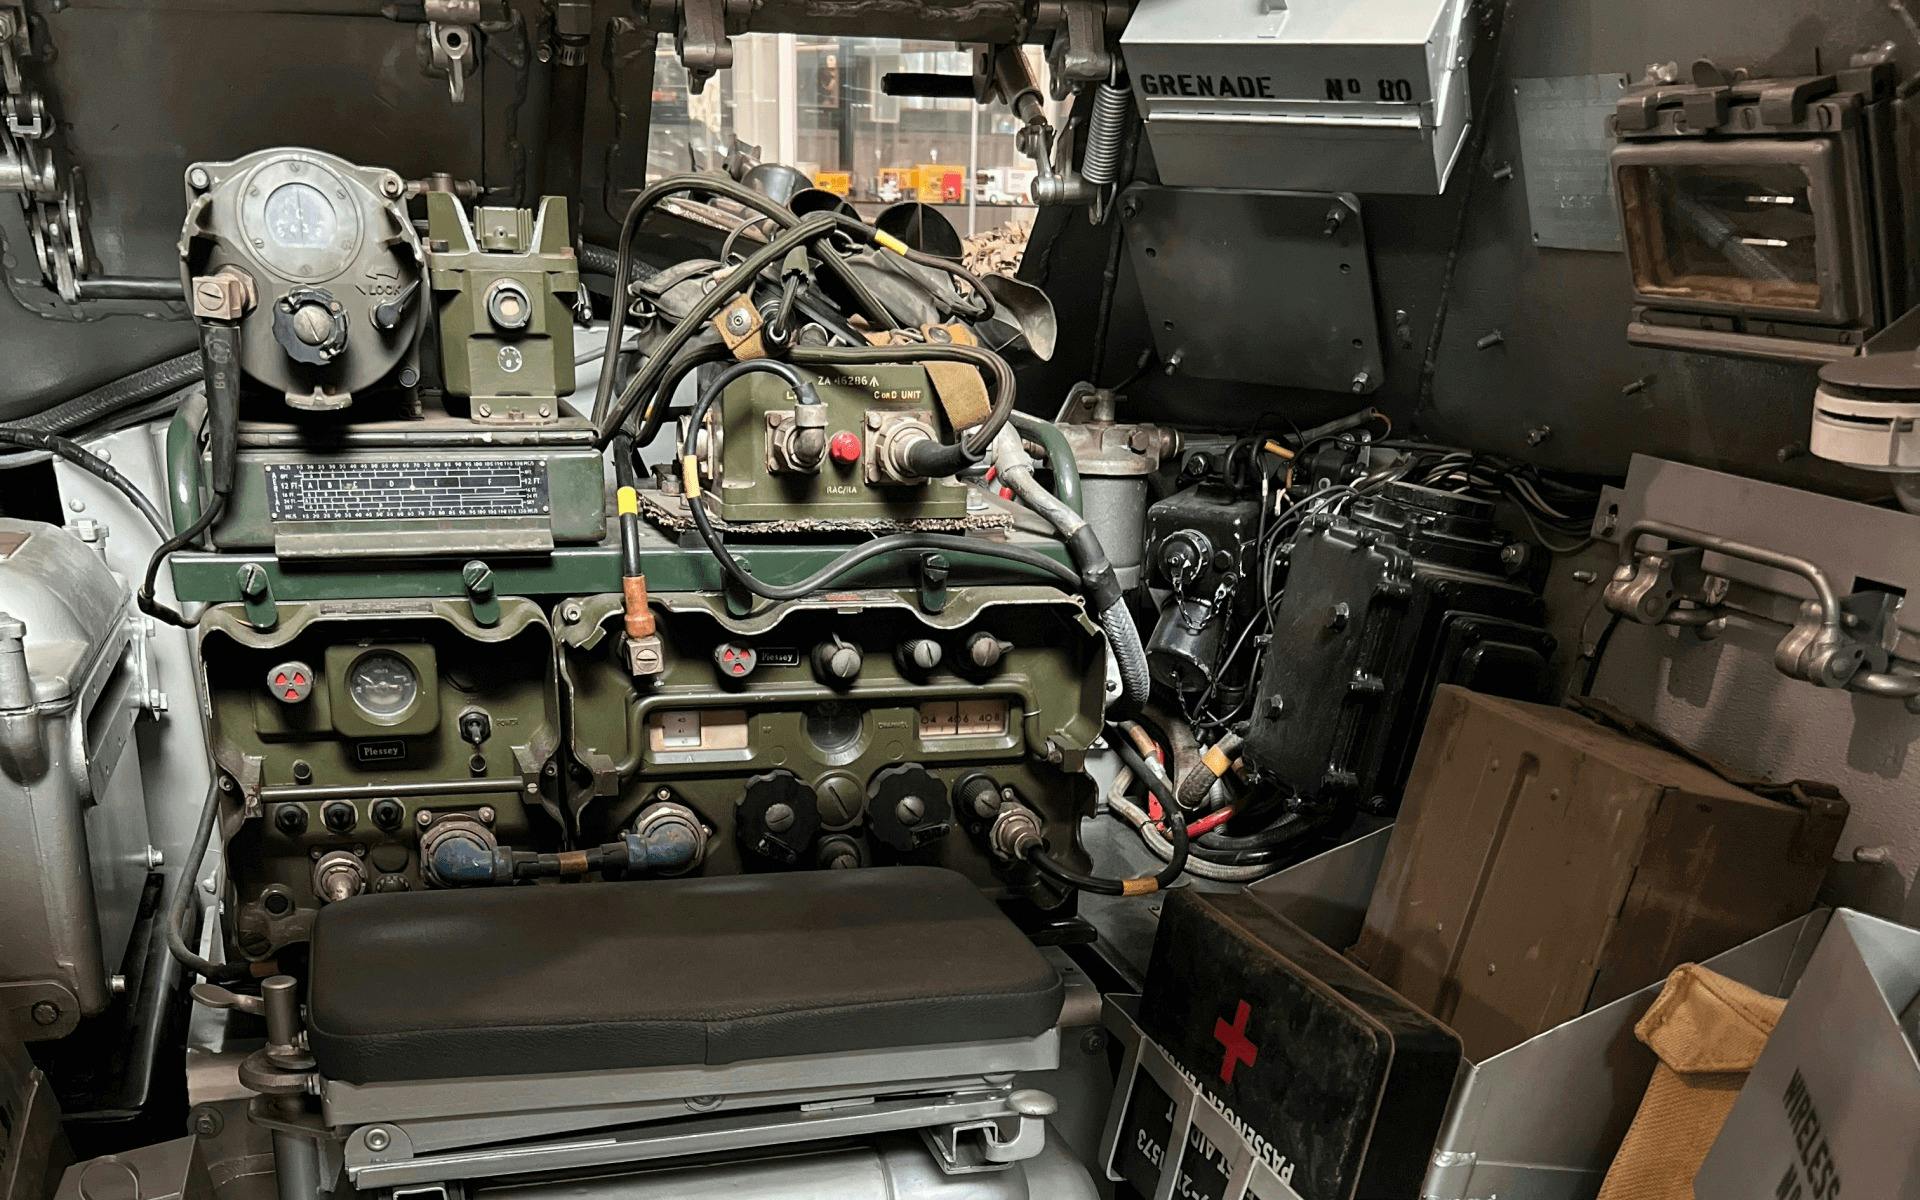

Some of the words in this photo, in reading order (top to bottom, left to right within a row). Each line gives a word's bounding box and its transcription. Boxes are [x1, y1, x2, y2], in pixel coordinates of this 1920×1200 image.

[1140, 73, 1275, 98] GRENADE
[1377, 78, 1413, 102] 80
[368, 284, 401, 296] LOCK
[901, 390, 922, 399] UNIT
[364, 746, 398, 756] Plessey
[1782, 1066, 1840, 1200] WIRELESS
